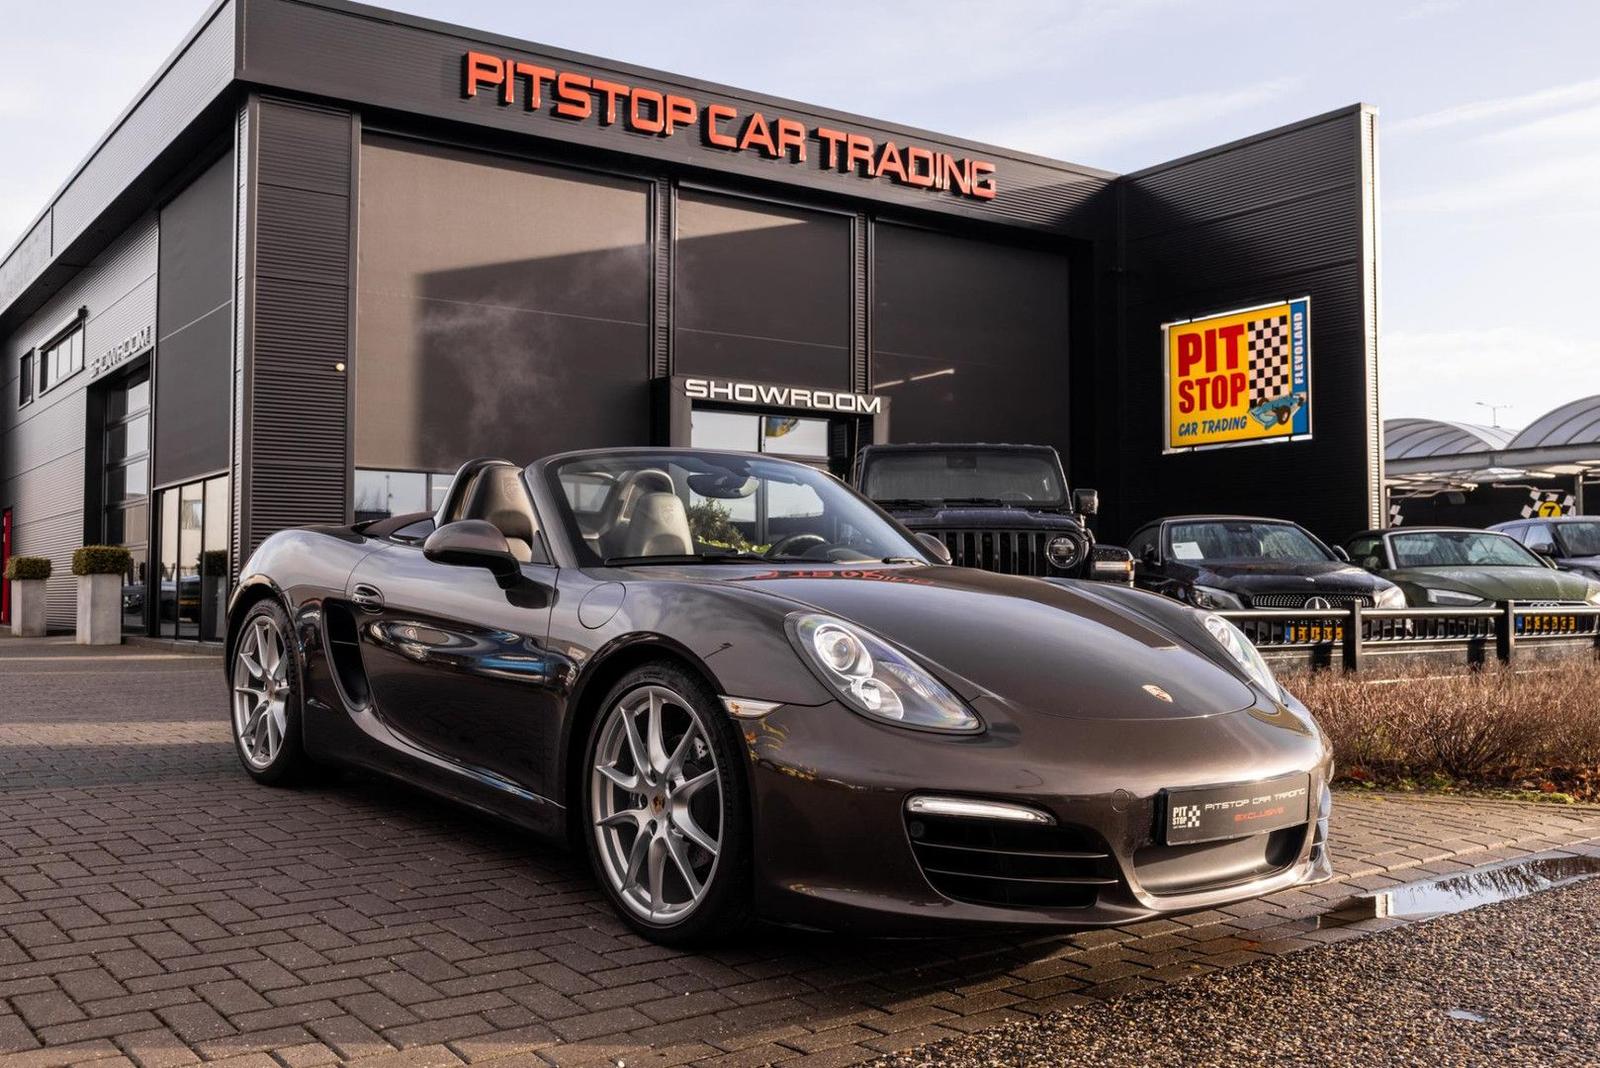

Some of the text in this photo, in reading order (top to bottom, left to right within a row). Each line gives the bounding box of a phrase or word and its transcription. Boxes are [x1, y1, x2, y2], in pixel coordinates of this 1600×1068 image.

[466, 50, 997, 199] PITSTOP CAR TRADING
[1177, 324, 1244, 377] PIT
[1294, 312, 1304, 385] FLEVOLAND
[684, 378, 882, 414] SHOWROOM
[1178, 372, 1246, 414] STOP
[1178, 415, 1248, 437] CAR TRADING
[1544, 505, 1556, 517] 7
[1172, 806, 1188, 817] PIT
[1204, 798, 1250, 811] PITSTOP
[1252, 795, 1272, 805] CAR
[1172, 817, 1187, 826] STOP
